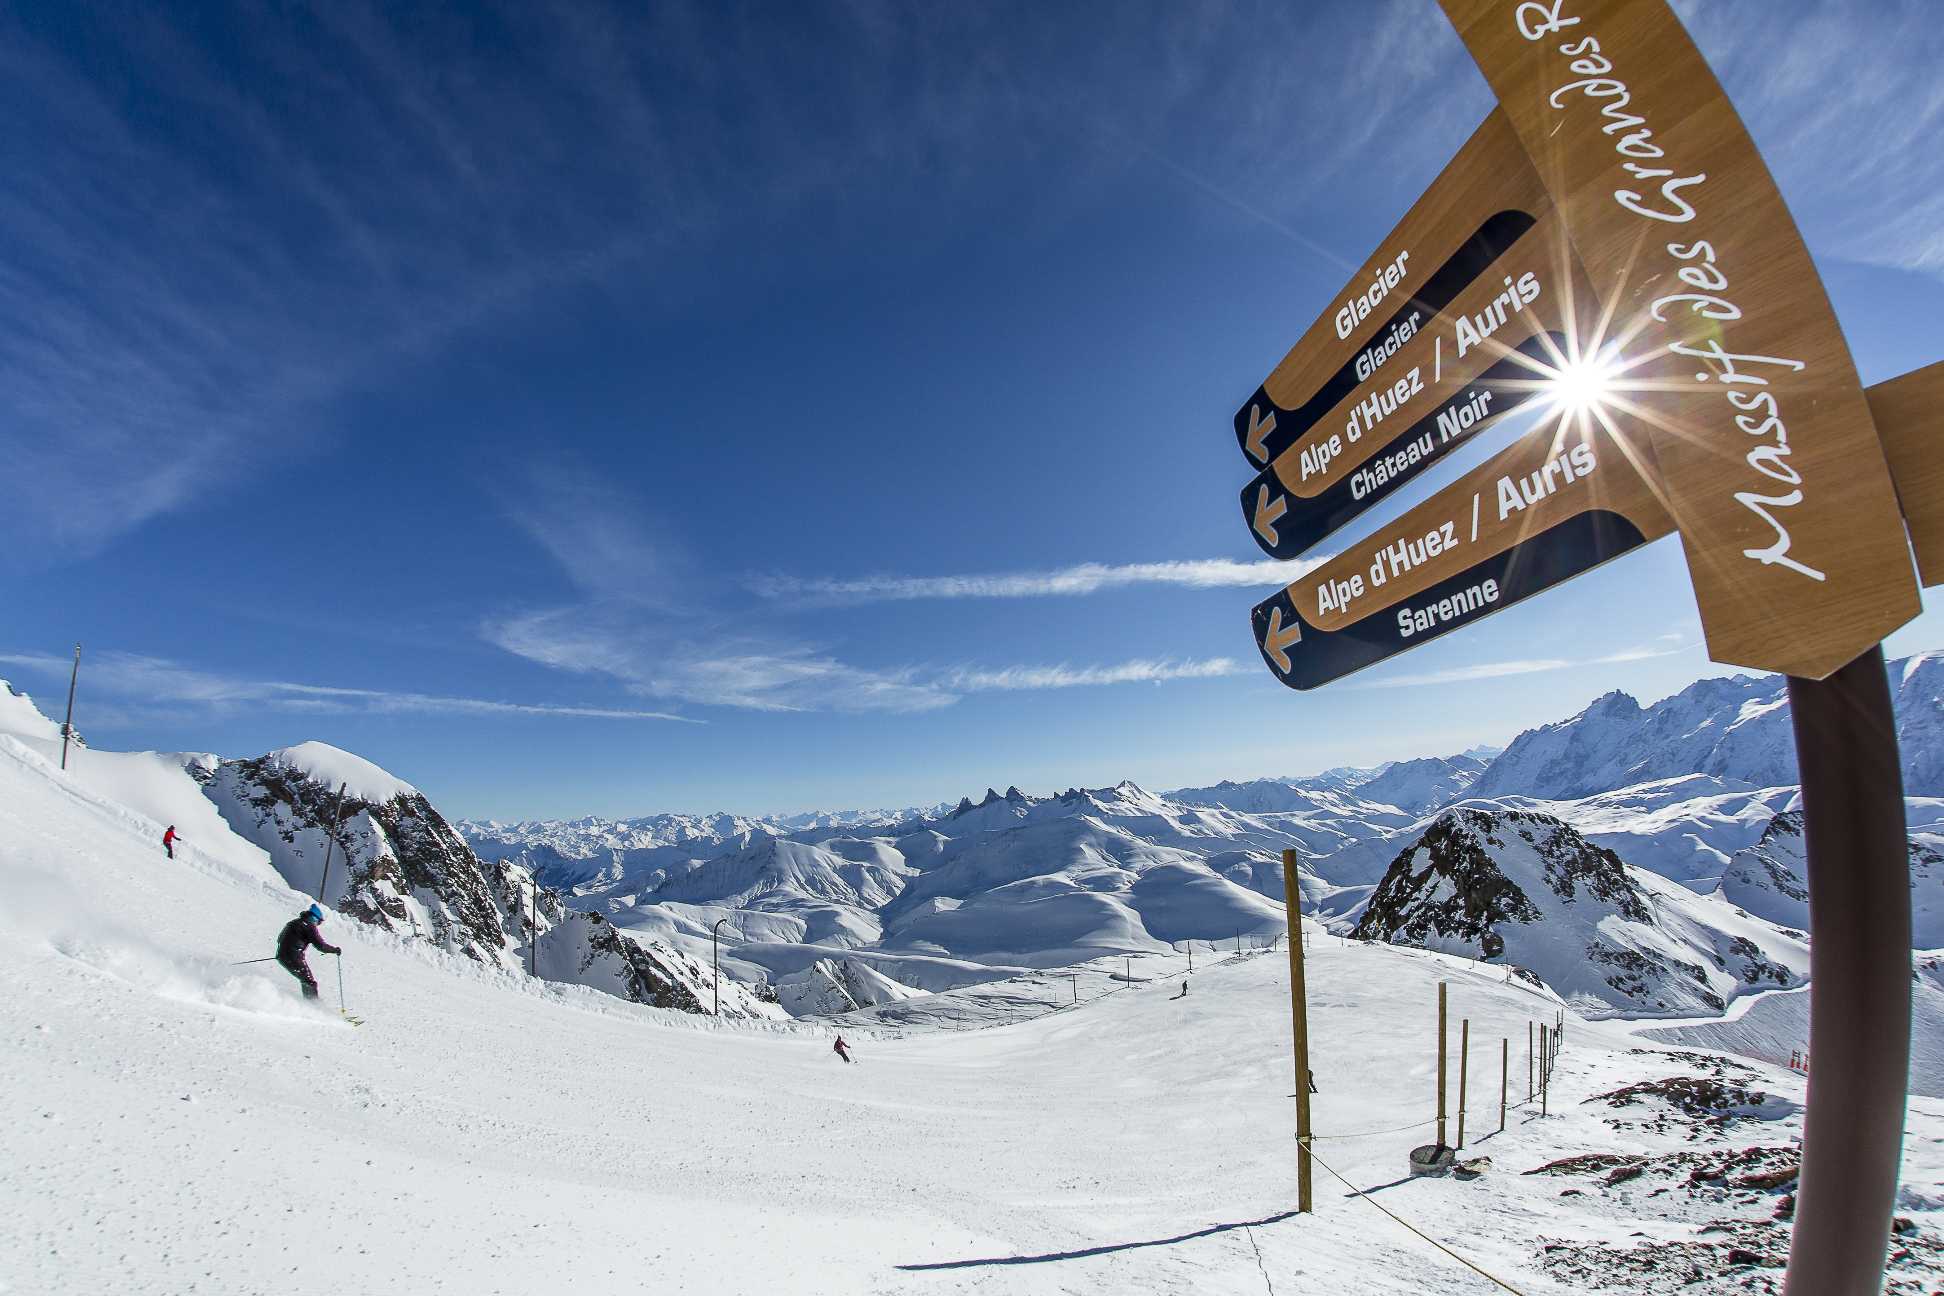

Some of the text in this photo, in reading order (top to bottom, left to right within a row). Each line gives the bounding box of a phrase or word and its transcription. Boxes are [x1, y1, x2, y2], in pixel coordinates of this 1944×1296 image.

[1549, 36, 1707, 224] Grandes
[1334, 249, 1410, 340] Glacier
[1355, 311, 1420, 382] Glacier
[1300, 271, 1541, 482] Alpe d'Huez / Auris
[1350, 389, 1492, 501] Château Noir
[1317, 441, 1597, 616] Alpe d'Huez / Auris
[1668, 339, 1826, 581] Massif
[1398, 577, 1499, 638] Sarenne
